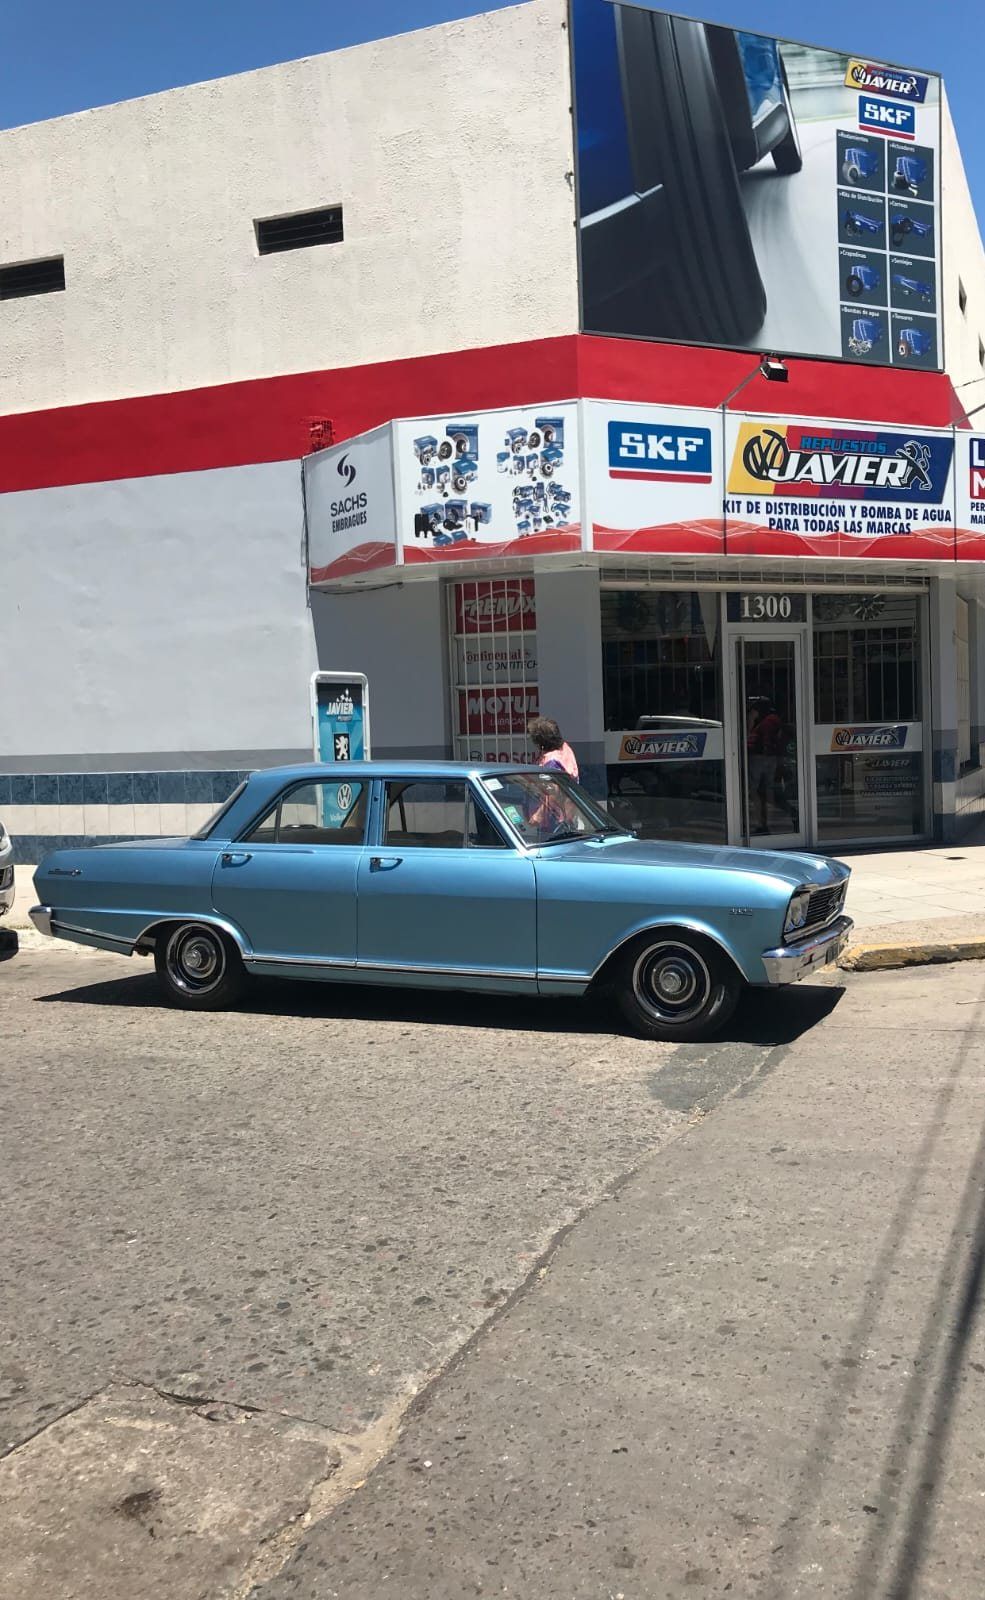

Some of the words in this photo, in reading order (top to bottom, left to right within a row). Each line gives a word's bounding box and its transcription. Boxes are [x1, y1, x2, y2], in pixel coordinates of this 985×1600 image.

[859, 74, 911, 94] JAVIER
[864, 103, 911, 125] SKF
[619, 432, 704, 461] SKF
[801, 436, 888, 454] REPUESTOS
[767, 452, 909, 487] JAVIER
[330, 492, 367, 517] SACHS
[723, 500, 742, 514] KIT
[746, 501, 761, 514] DE
[765, 501, 845, 518] DISTRIBUCIÓN
[849, 504, 857, 517] Y
[861, 505, 901, 519] BOMBA
[905, 507, 919, 520] DE
[922, 508, 952, 522] AGUA
[332, 510, 367, 533] EMBRAGUES
[769, 517, 799, 531] PARA
[803, 518, 839, 533] TODAS
[844, 519, 862, 534] LAS
[867, 520, 911, 535] MARCAS
[741, 595, 791, 618] 1300
[463, 649, 523, 664] Continenal
[326, 702, 354, 715] JAVIER
[469, 696, 540, 715] MOTUL
[634, 741, 688, 755] JAVIER
[844, 734, 891, 746] JAVIER
